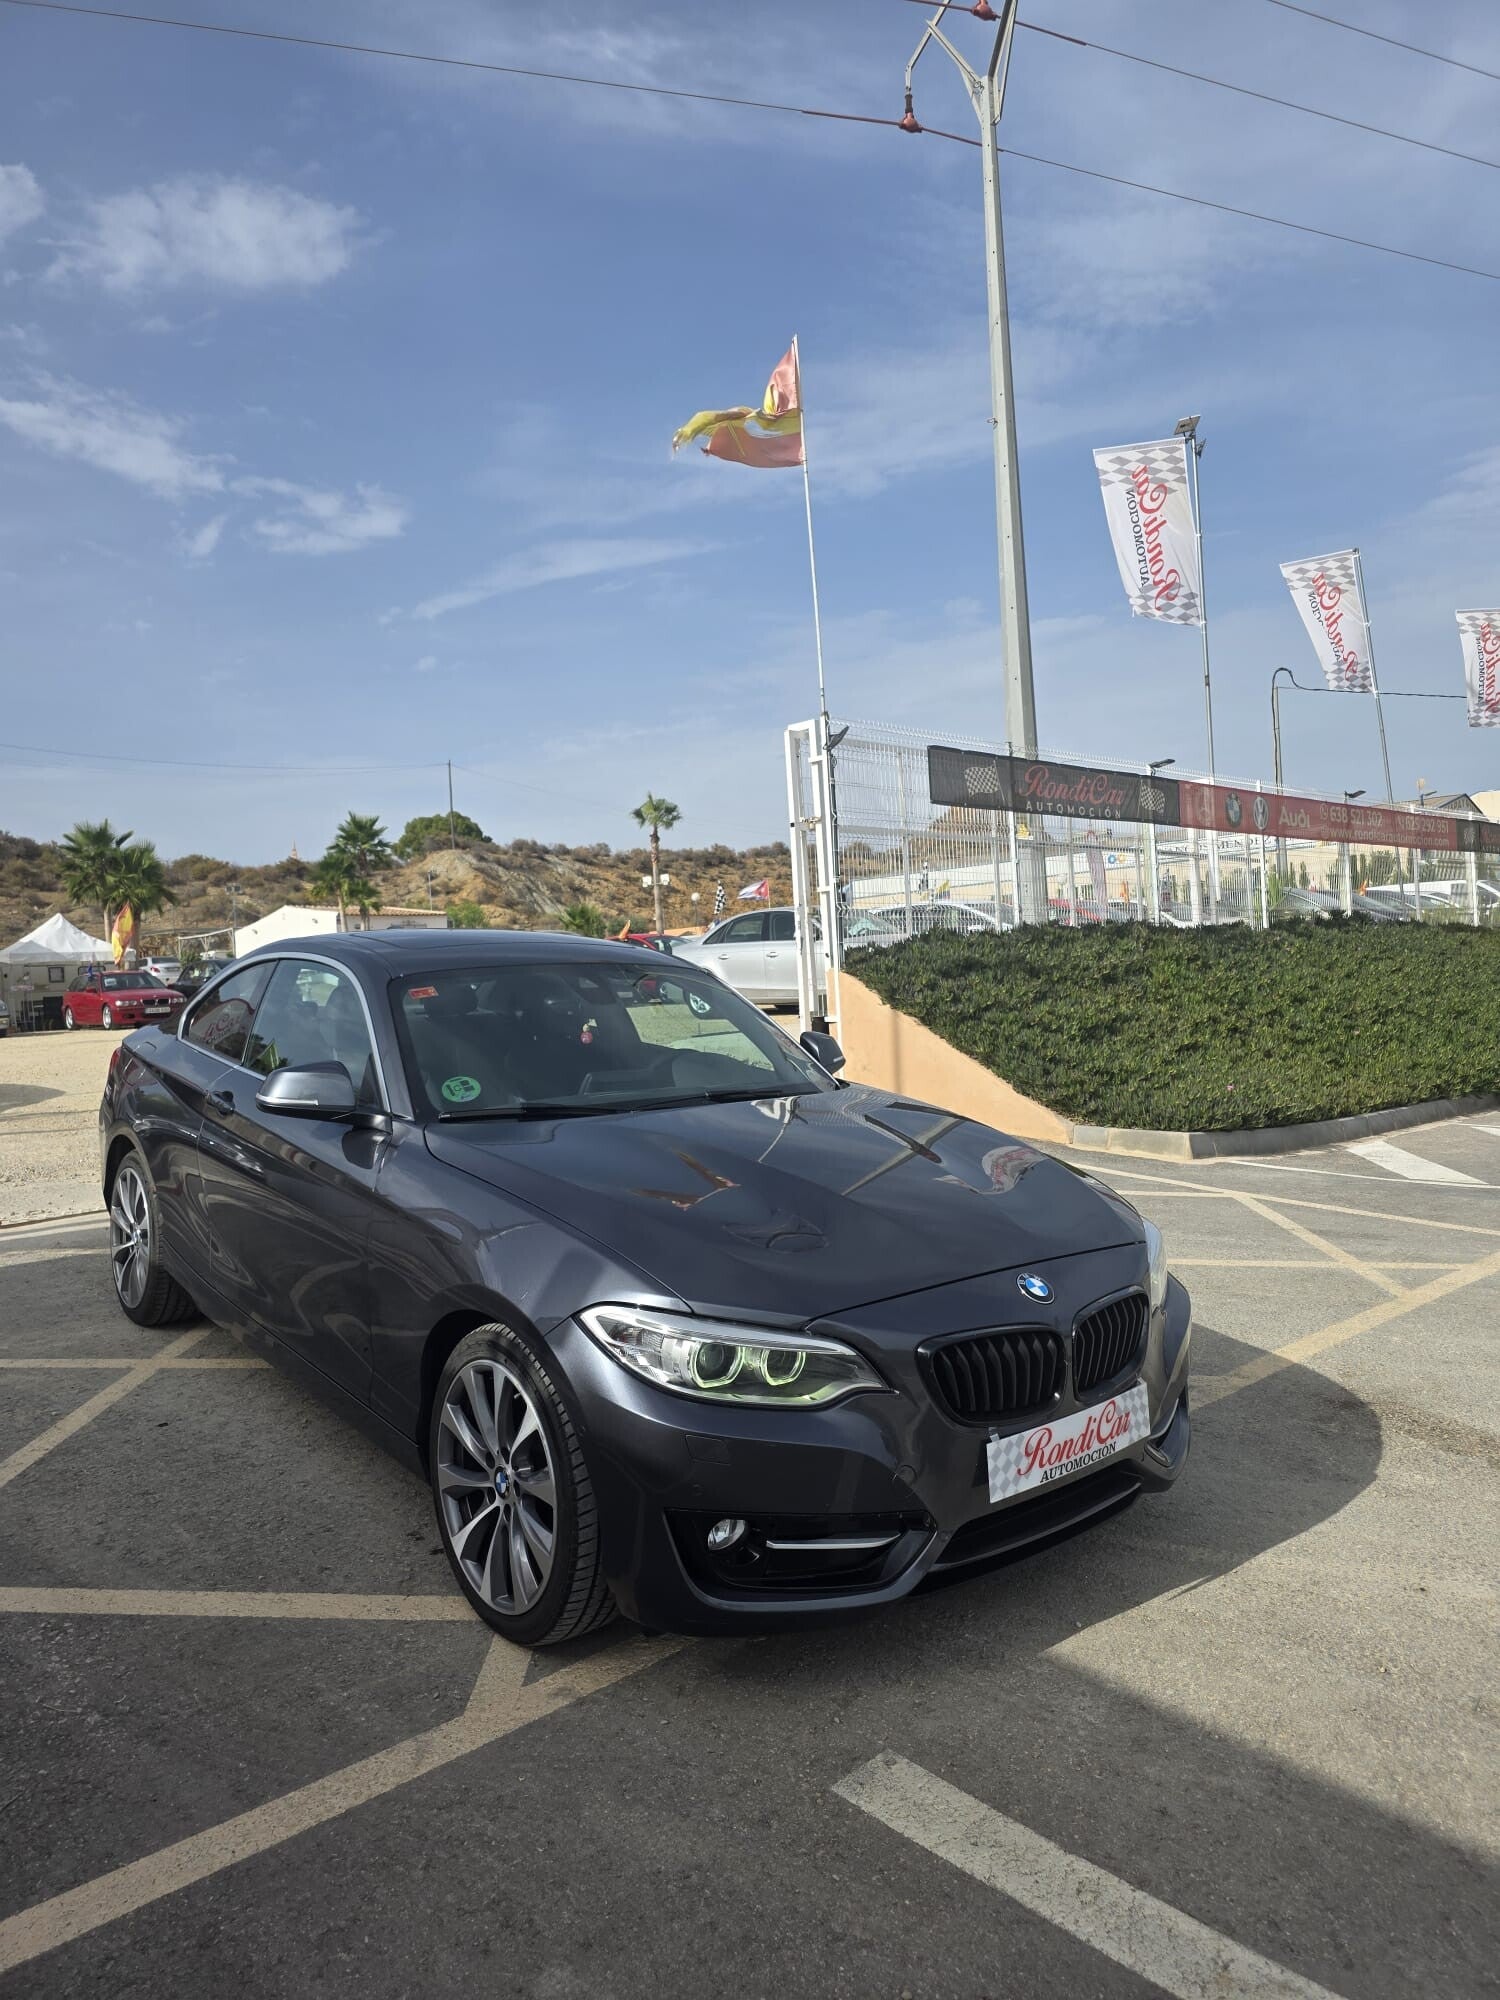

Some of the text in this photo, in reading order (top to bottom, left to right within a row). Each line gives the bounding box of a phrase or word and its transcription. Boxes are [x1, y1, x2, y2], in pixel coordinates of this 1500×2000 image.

[1018, 764, 1127, 806] RondiCar
[1025, 801, 1121, 819] AUTOMOCIÓN
[1330, 805, 1384, 827] 638 521 302
[1017, 1399, 1131, 1476] RondiCar
